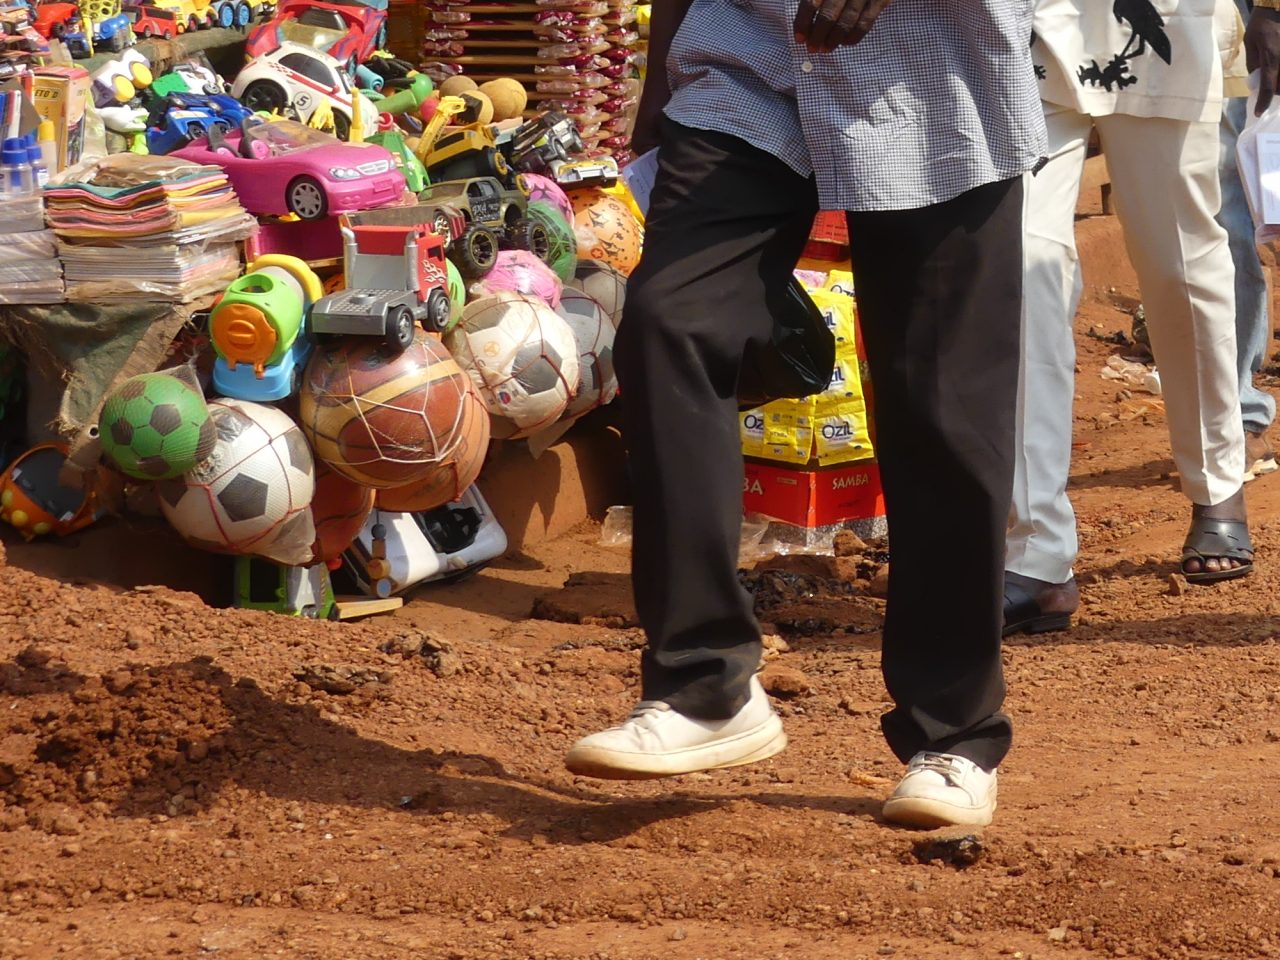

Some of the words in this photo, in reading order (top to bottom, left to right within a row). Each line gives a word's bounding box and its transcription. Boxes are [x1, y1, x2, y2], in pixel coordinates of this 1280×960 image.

[296, 95, 308, 107] 5
[744, 414, 764, 430] Oz
[832, 473, 869, 490] SAMBA
